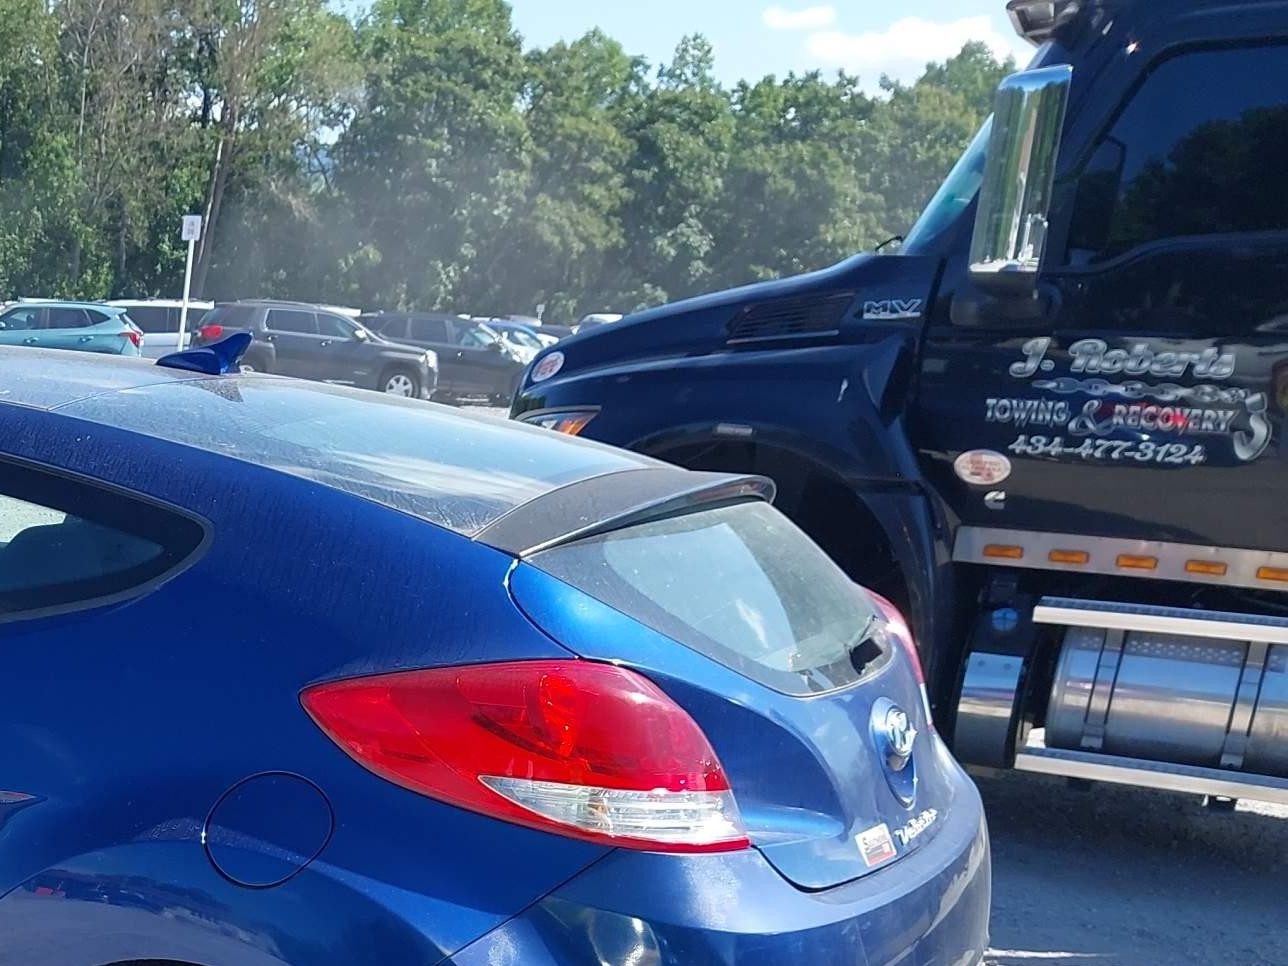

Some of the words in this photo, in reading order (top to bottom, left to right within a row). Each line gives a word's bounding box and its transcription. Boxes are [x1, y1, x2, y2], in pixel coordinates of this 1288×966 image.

[1008, 336, 1056, 378] J.
[1068, 338, 1236, 380] Roberts
[985, 397, 1071, 426] TOWING
[1067, 399, 1115, 435] &
[1111, 403, 1236, 433] RECOVERY
[1008, 434, 1206, 465] 434-477-3124
